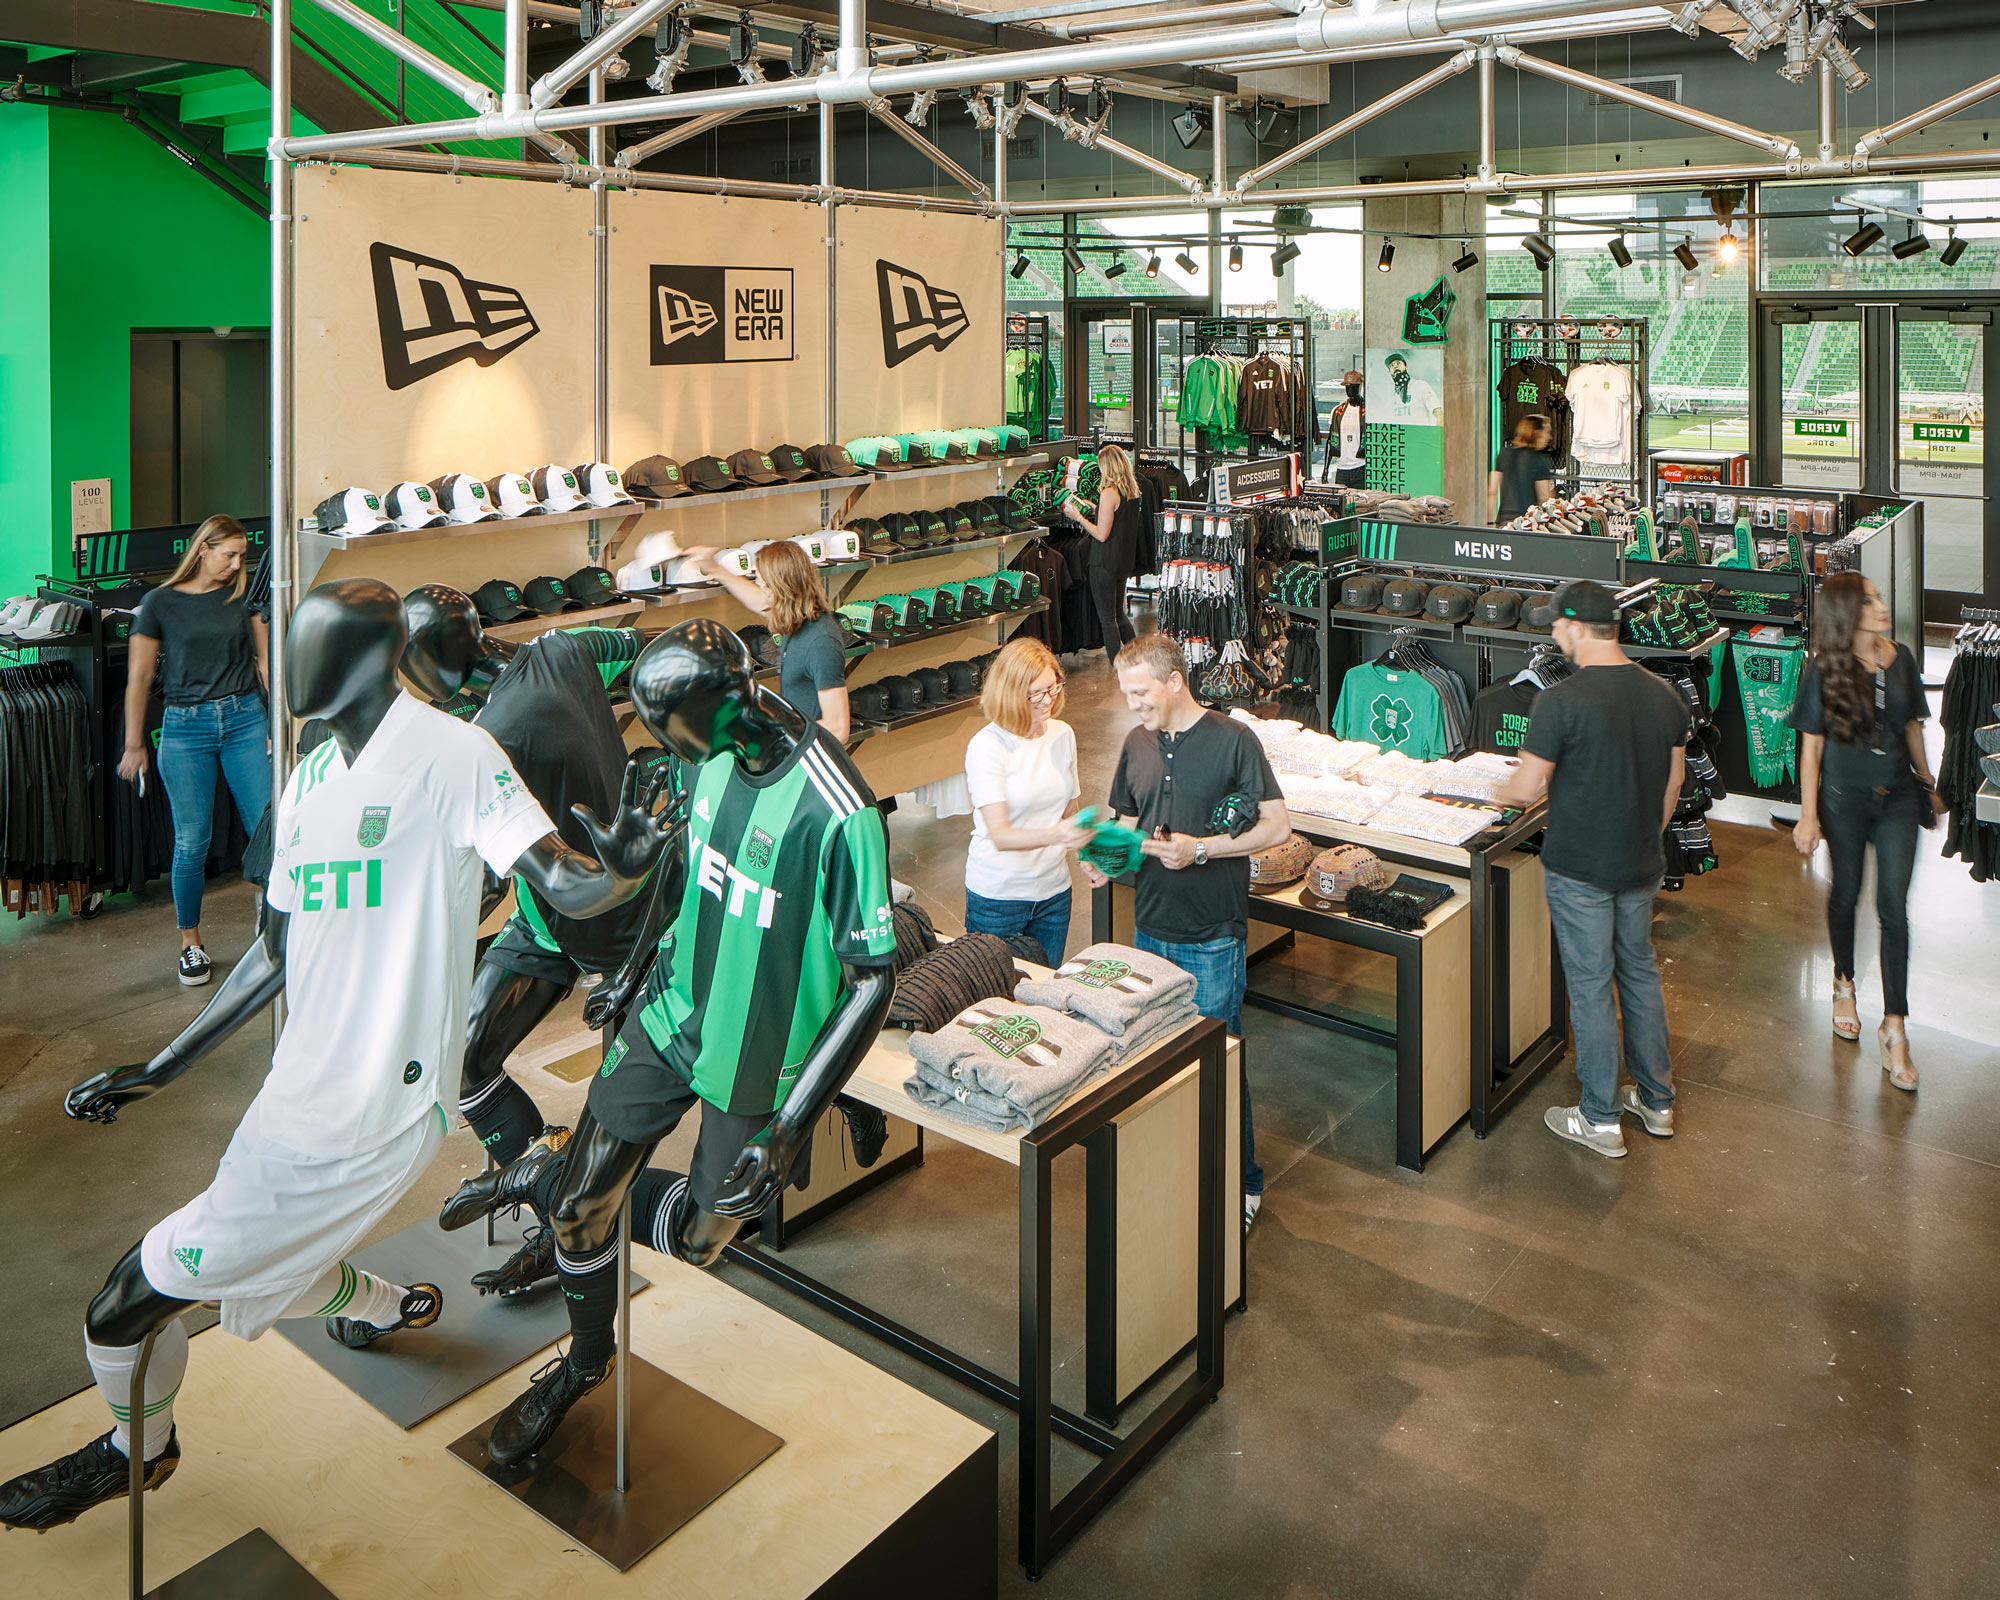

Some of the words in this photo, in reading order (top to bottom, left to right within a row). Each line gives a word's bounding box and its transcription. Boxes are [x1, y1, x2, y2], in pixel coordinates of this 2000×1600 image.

[735, 288, 783, 313] NEW
[735, 316, 783, 340] ERA
[1366, 432, 1405, 444] ATXFC
[1366, 444, 1405, 457] ATXFC
[1366, 456, 1405, 469] ATXFC
[1236, 468, 1280, 487] ACCESSORIES
[1366, 469, 1405, 482] ATXFC
[78, 497, 104, 506] LEVEL
[81, 487, 101, 497] 100
[1328, 531, 1358, 551] AUSTIN
[1454, 540, 1512, 561] MEN'S
[1744, 691, 1758, 721] SOMOS
[1502, 713, 1531, 733] FORE
[1750, 724, 1765, 756] VERDES
[365, 809, 387, 817] AUSTIN
[289, 858, 382, 912] YETI
[977, 1028, 1011, 1055] AUSTIN
[1567, 1117, 1582, 1135] N
[174, 1248, 200, 1277] adidas
